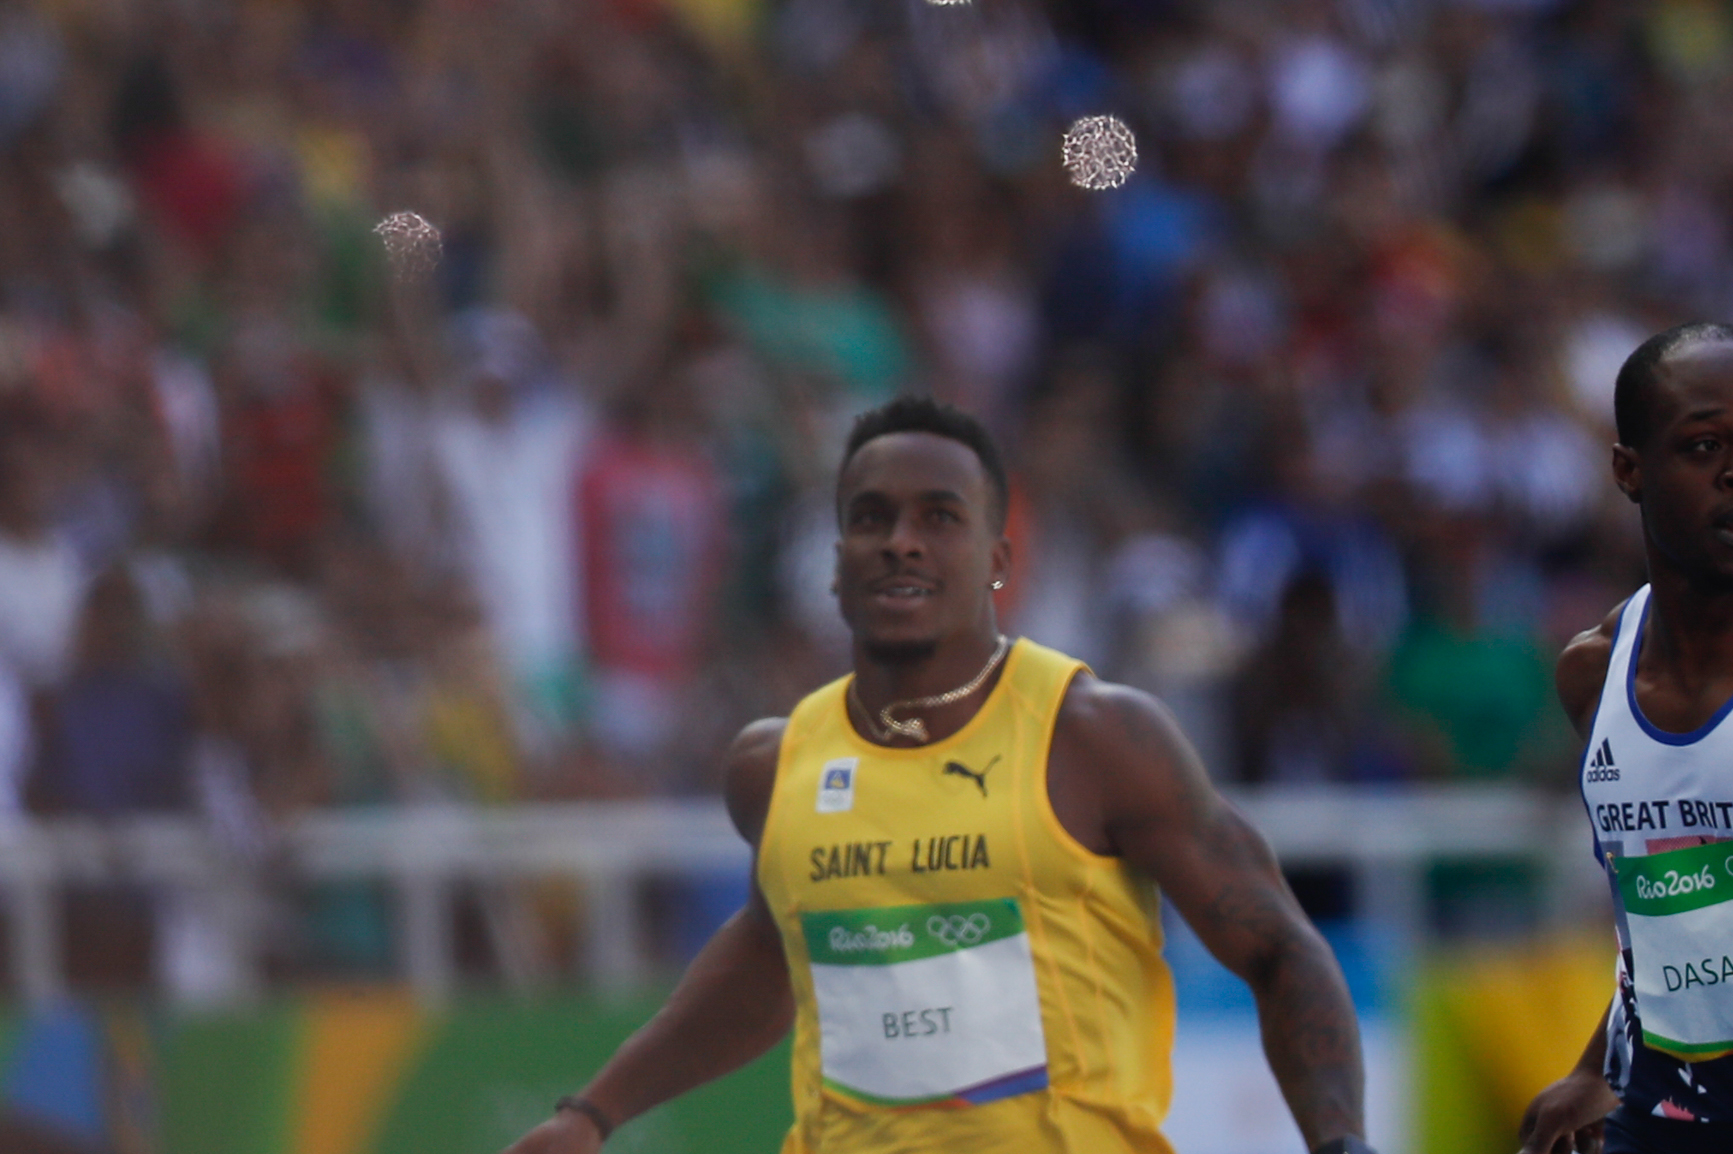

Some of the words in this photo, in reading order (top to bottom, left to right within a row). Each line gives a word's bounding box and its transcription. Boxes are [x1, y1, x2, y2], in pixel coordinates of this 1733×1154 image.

[1587, 767, 1620, 783] adidas
[1596, 801, 1669, 832] GREAT
[810, 841, 893, 882] SAINT
[911, 834, 990, 874] LUCIA
[1636, 865, 1715, 899] Rio2016
[882, 1007, 953, 1038] BEST
